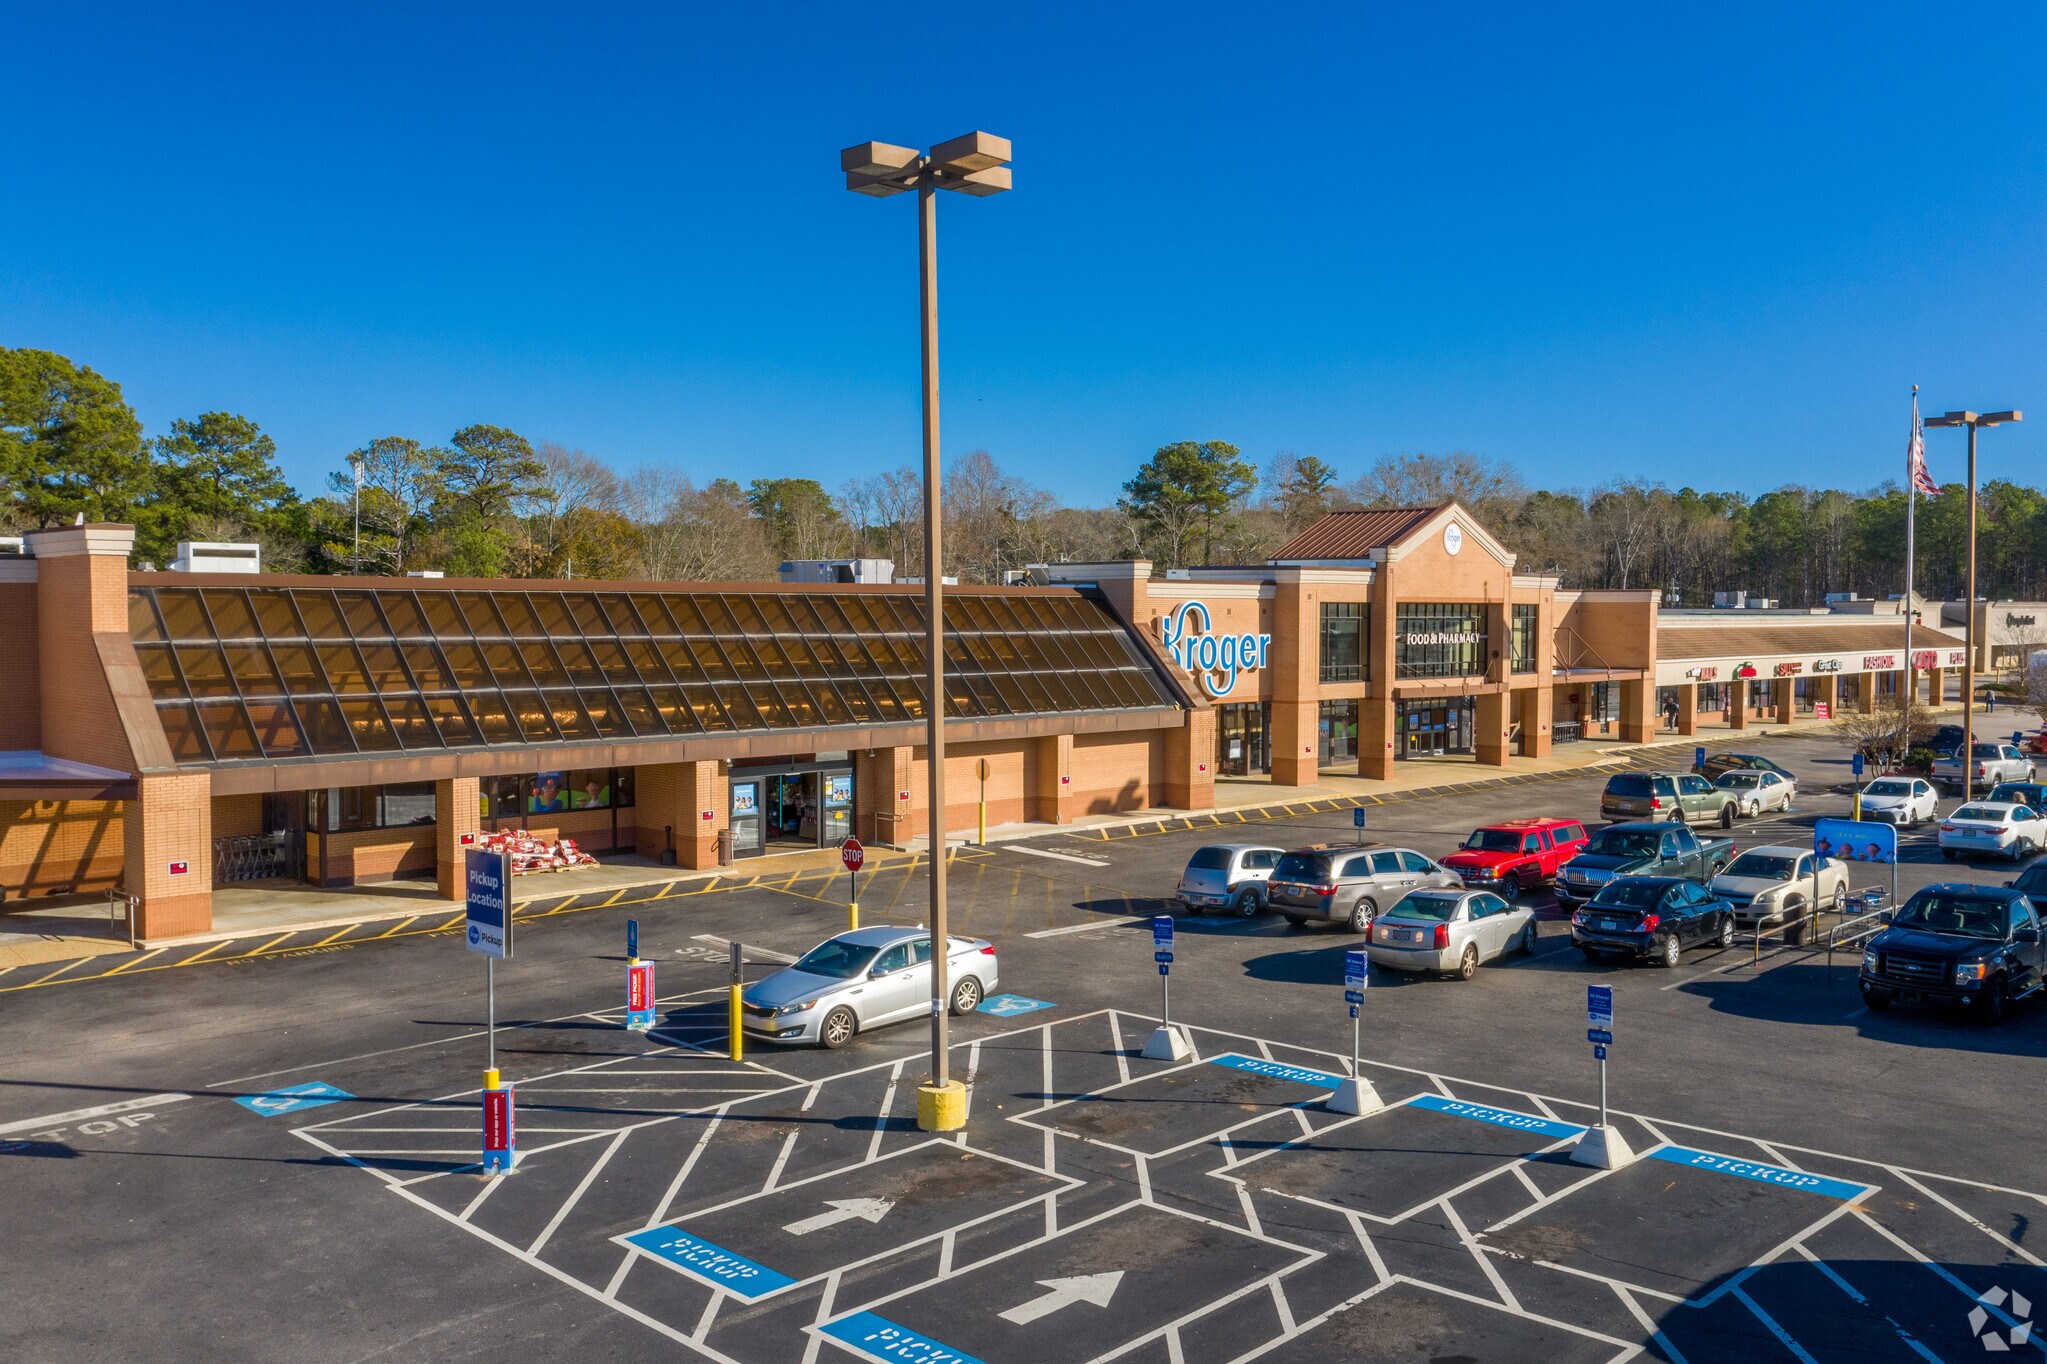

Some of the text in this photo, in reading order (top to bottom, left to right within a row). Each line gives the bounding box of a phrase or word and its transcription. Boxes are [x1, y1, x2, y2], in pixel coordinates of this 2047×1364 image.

[1162, 600, 1271, 697] Kroger
[1407, 633, 1430, 645] FOOD
[1438, 632, 1480, 644] PHARMACY
[1865, 655, 1895, 670] FASHIONS
[1914, 651, 1938, 670] CATO
[843, 848, 863, 863] STOP
[470, 869, 499, 891] Pickup
[467, 890, 503, 910] Location
[481, 932, 503, 948] Pickup
[1237, 1061, 1326, 1081] PICKUP
[1442, 1103, 1547, 1128] PICKUP
[1691, 1155, 1820, 1186] PICKUP
[660, 1238, 759, 1278] PICKUP
[864, 1328, 972, 1364] PICK
